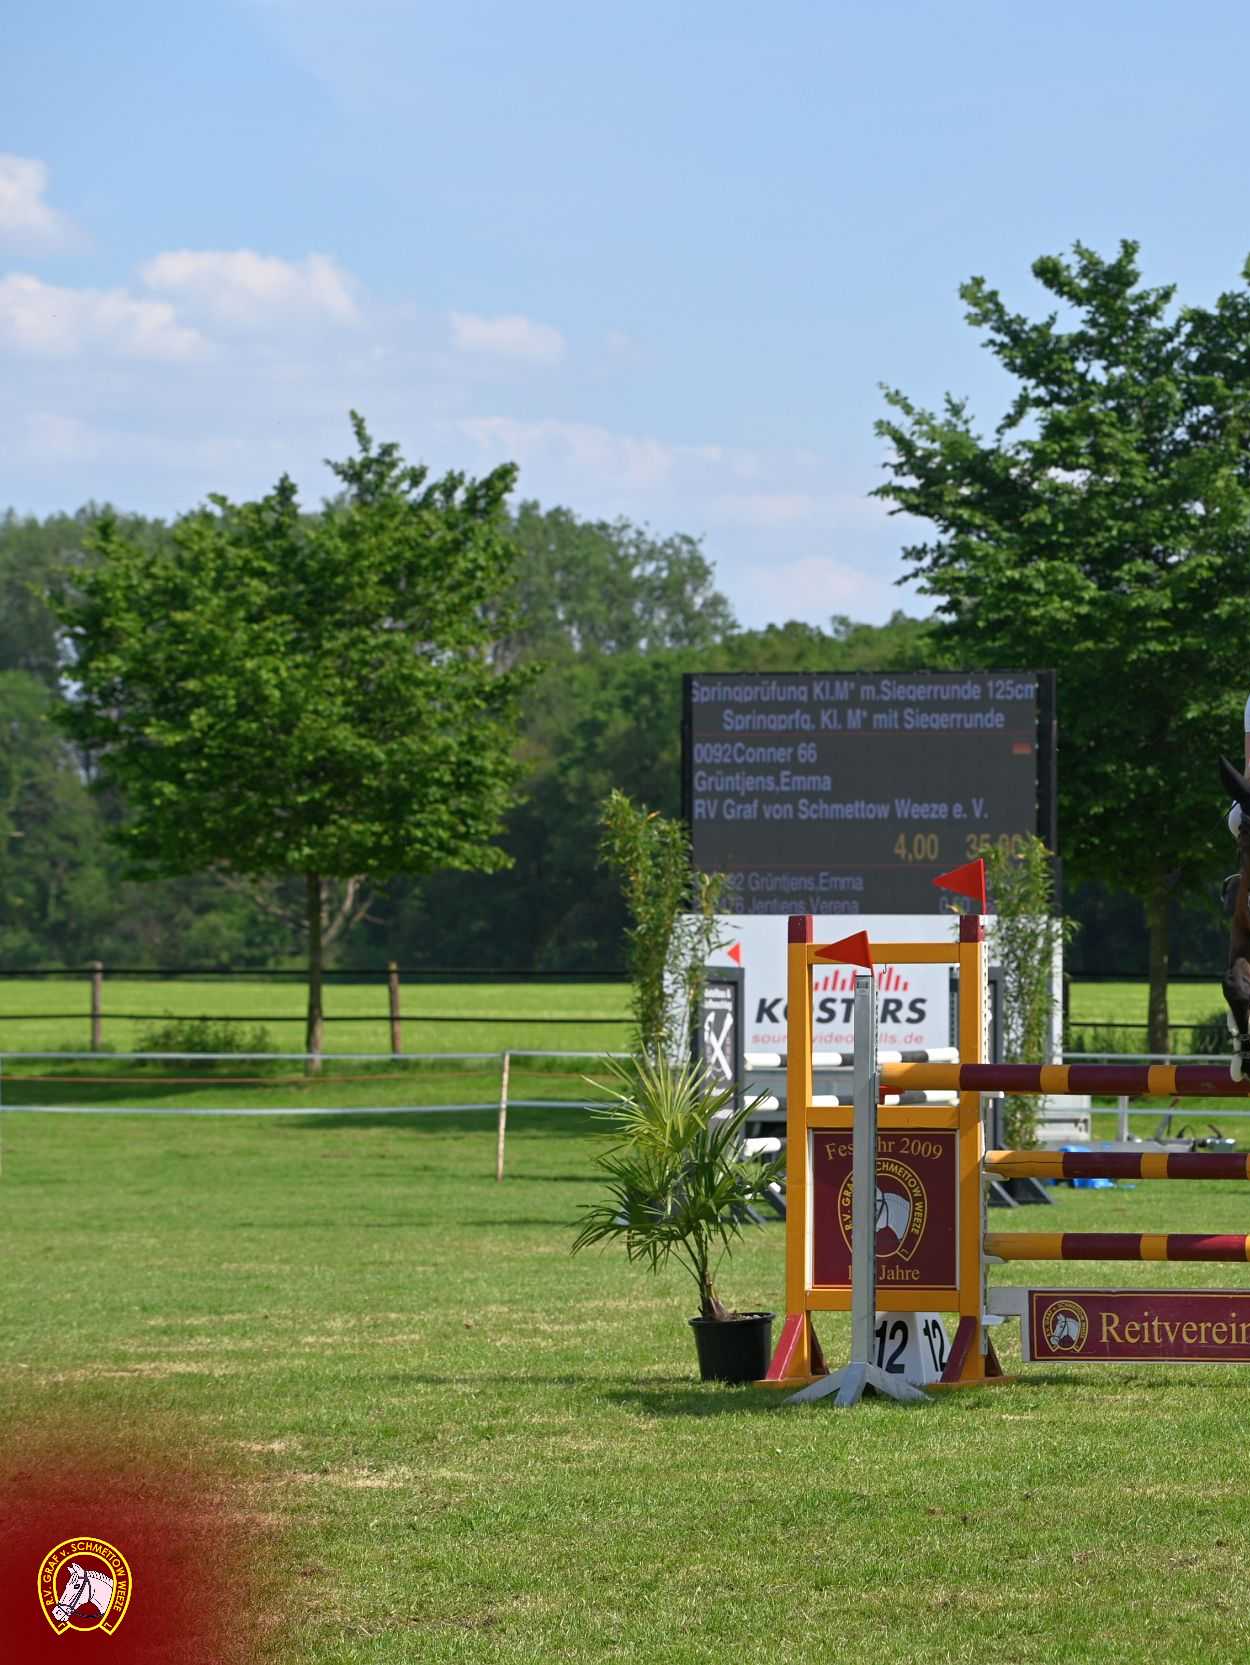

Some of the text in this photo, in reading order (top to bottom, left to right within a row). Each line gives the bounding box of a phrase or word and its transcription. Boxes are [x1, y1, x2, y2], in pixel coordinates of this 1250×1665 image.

[873, 708, 898, 729] mit
[903, 707, 1006, 731] Siegerrunde
[797, 742, 817, 763] 66
[694, 798, 988, 820] RV Graf von Schmettow Weeze e. V.
[894, 832, 939, 864] 4,00
[755, 998, 928, 1024] KSTRS
[900, 1137, 943, 1160] 2009
[876, 1161, 922, 1198] CHMETTOW
[911, 1201, 924, 1236] WEEZE
[879, 1264, 921, 1281] Jahre
[875, 1320, 909, 1374] 12
[923, 1319, 948, 1372] 12
